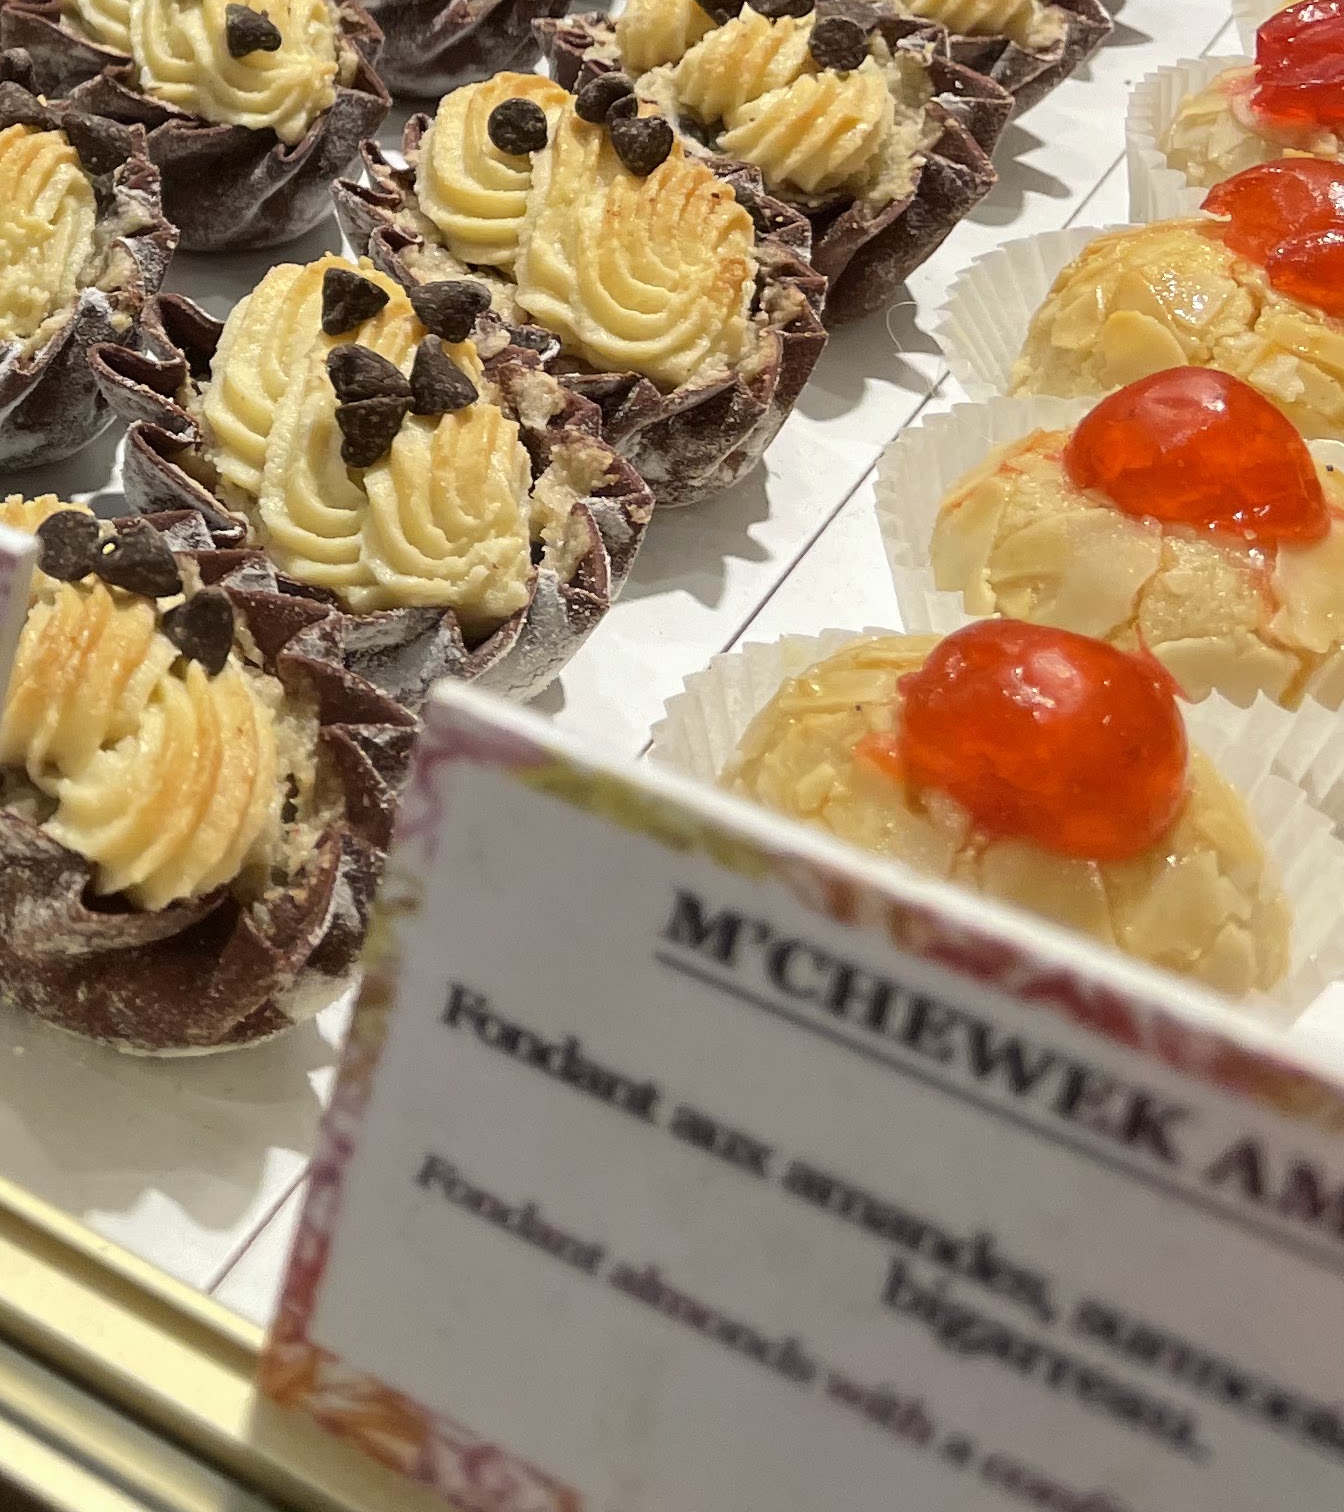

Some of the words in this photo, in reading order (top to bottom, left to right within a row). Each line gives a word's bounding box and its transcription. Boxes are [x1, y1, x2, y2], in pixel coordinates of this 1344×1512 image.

[442, 982, 660, 1124] Fondant
[416, 1153, 606, 1275] Fondant
[824, 1372, 936, 1451] with
